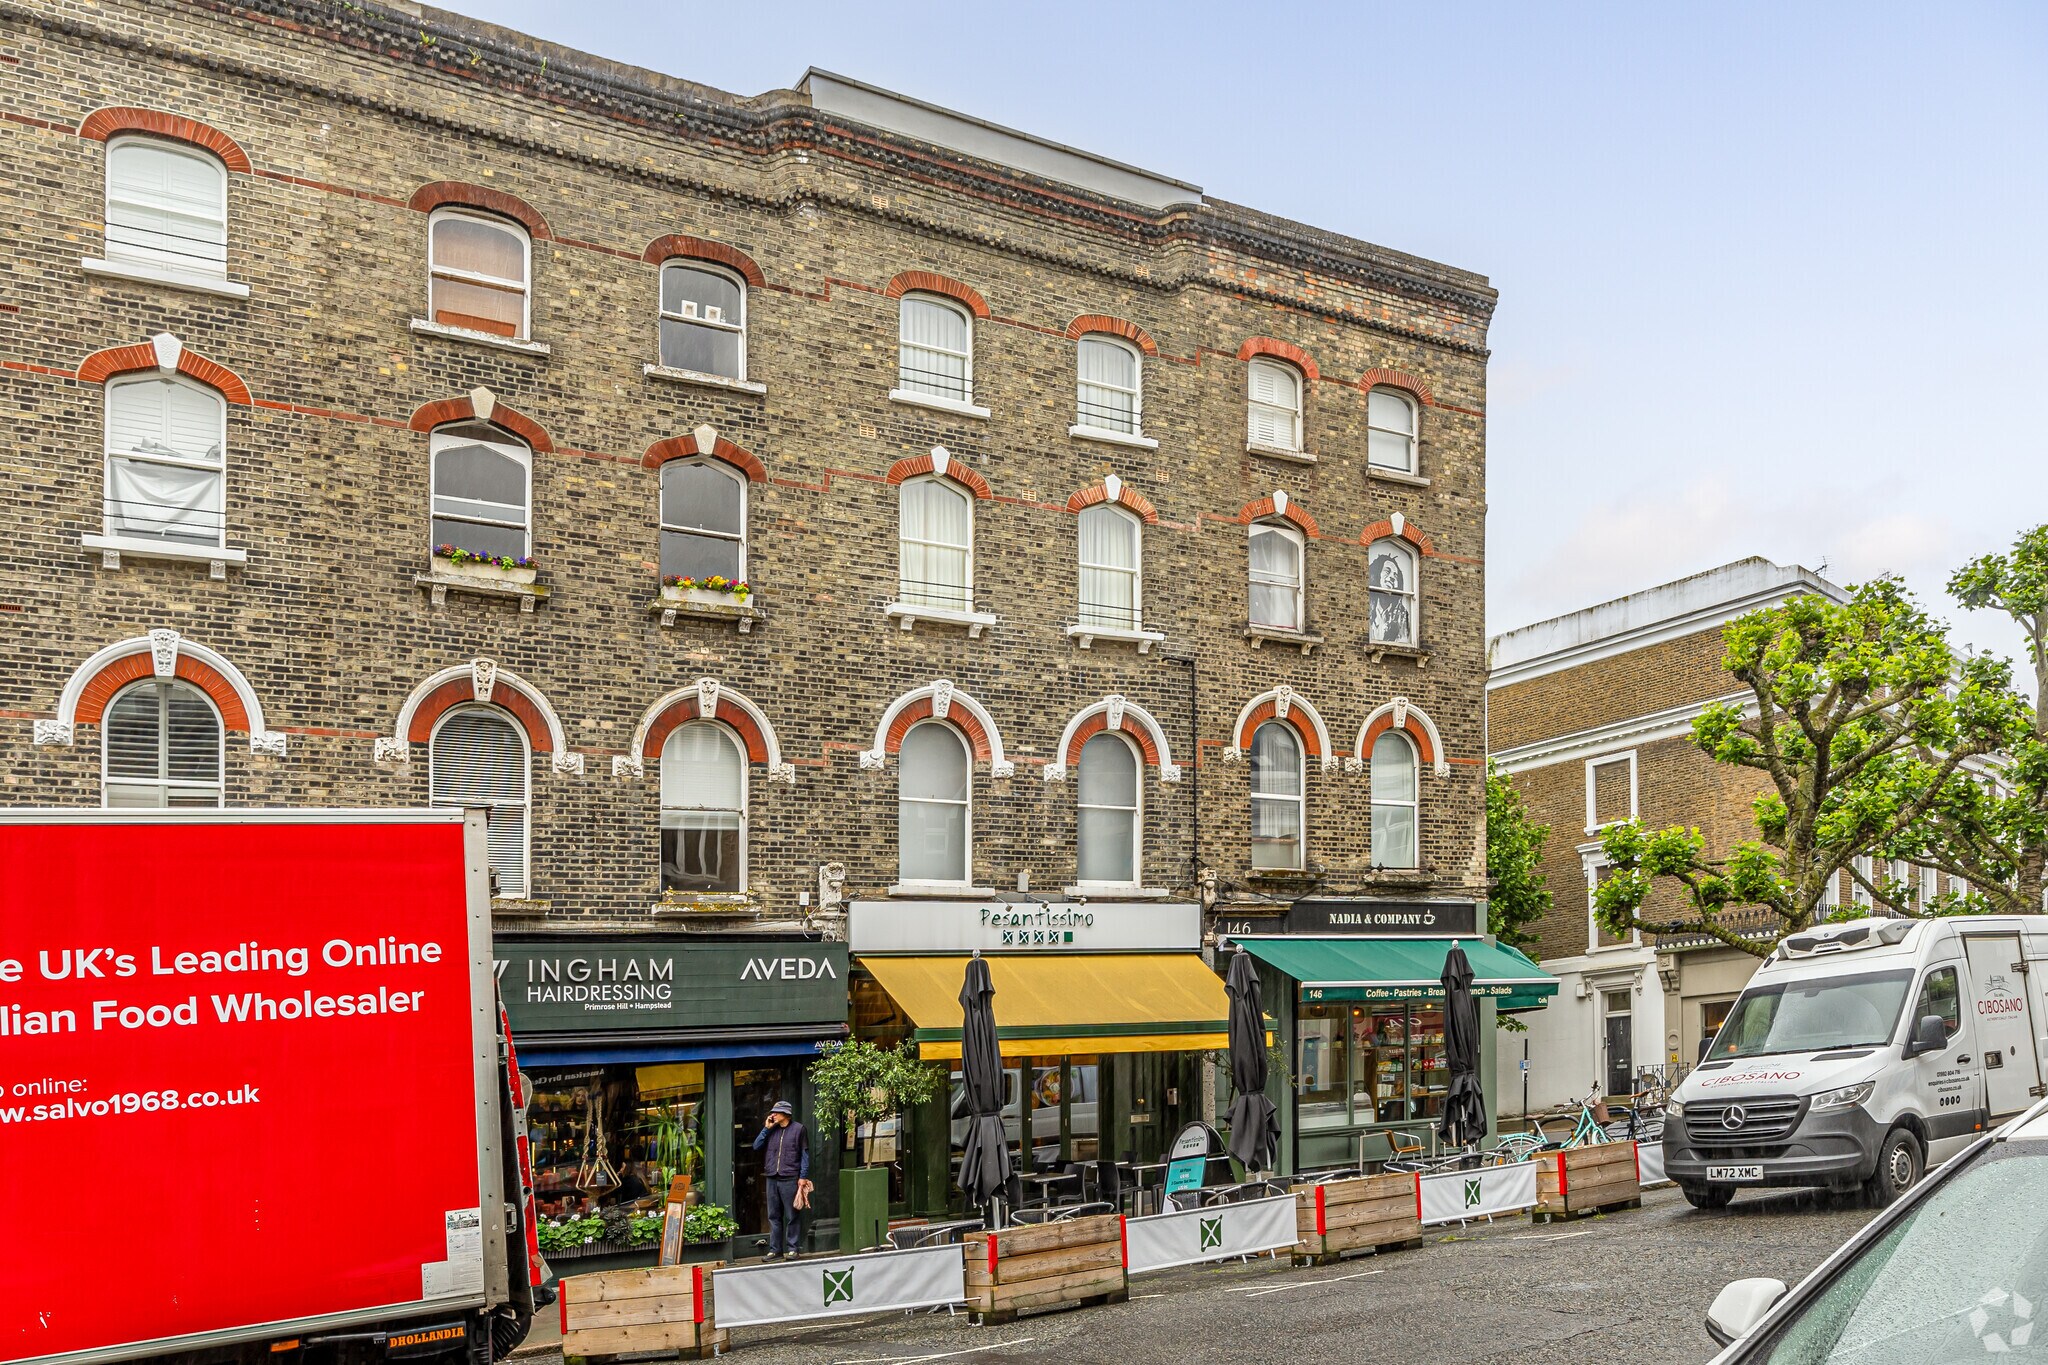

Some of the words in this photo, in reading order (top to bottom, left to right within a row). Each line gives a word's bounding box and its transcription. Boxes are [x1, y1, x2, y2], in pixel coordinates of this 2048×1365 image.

[980, 908, 1094, 927] Pesantissimo
[1329, 913, 1362, 924] NADIA
[1364, 914, 1372, 924] &
[1374, 914, 1422, 924] COMPANY
[1227, 922, 1251, 934] 146
[151, 942, 309, 976] Leading
[322, 937, 442, 968] Online
[528, 958, 673, 983] INGHAM
[740, 957, 837, 980] AVEDA
[527, 984, 672, 1002] HAIRDRESSING
[1309, 990, 1323, 999] 146
[1366, 988, 1390, 998] Coffee
[1394, 987, 1422, 997] Pastries
[1490, 986, 1512, 995] Salads
[92, 996, 198, 1030] Food
[211, 986, 425, 1023] Wholesaler
[584, 1003, 616, 1011] Primrose
[616, 1002, 629, 1010] Hill
[635, 1002, 672, 1011] Hampstead
[1978, 998, 2023, 1015] CIBOSANO
[1701, 1071, 1800, 1087] CIBOSANO
[1711, 1168, 1735, 1178] LM72
[1738, 1167, 1758, 1178] XMC
[389, 1326, 465, 1348] DHOLLANDIA
